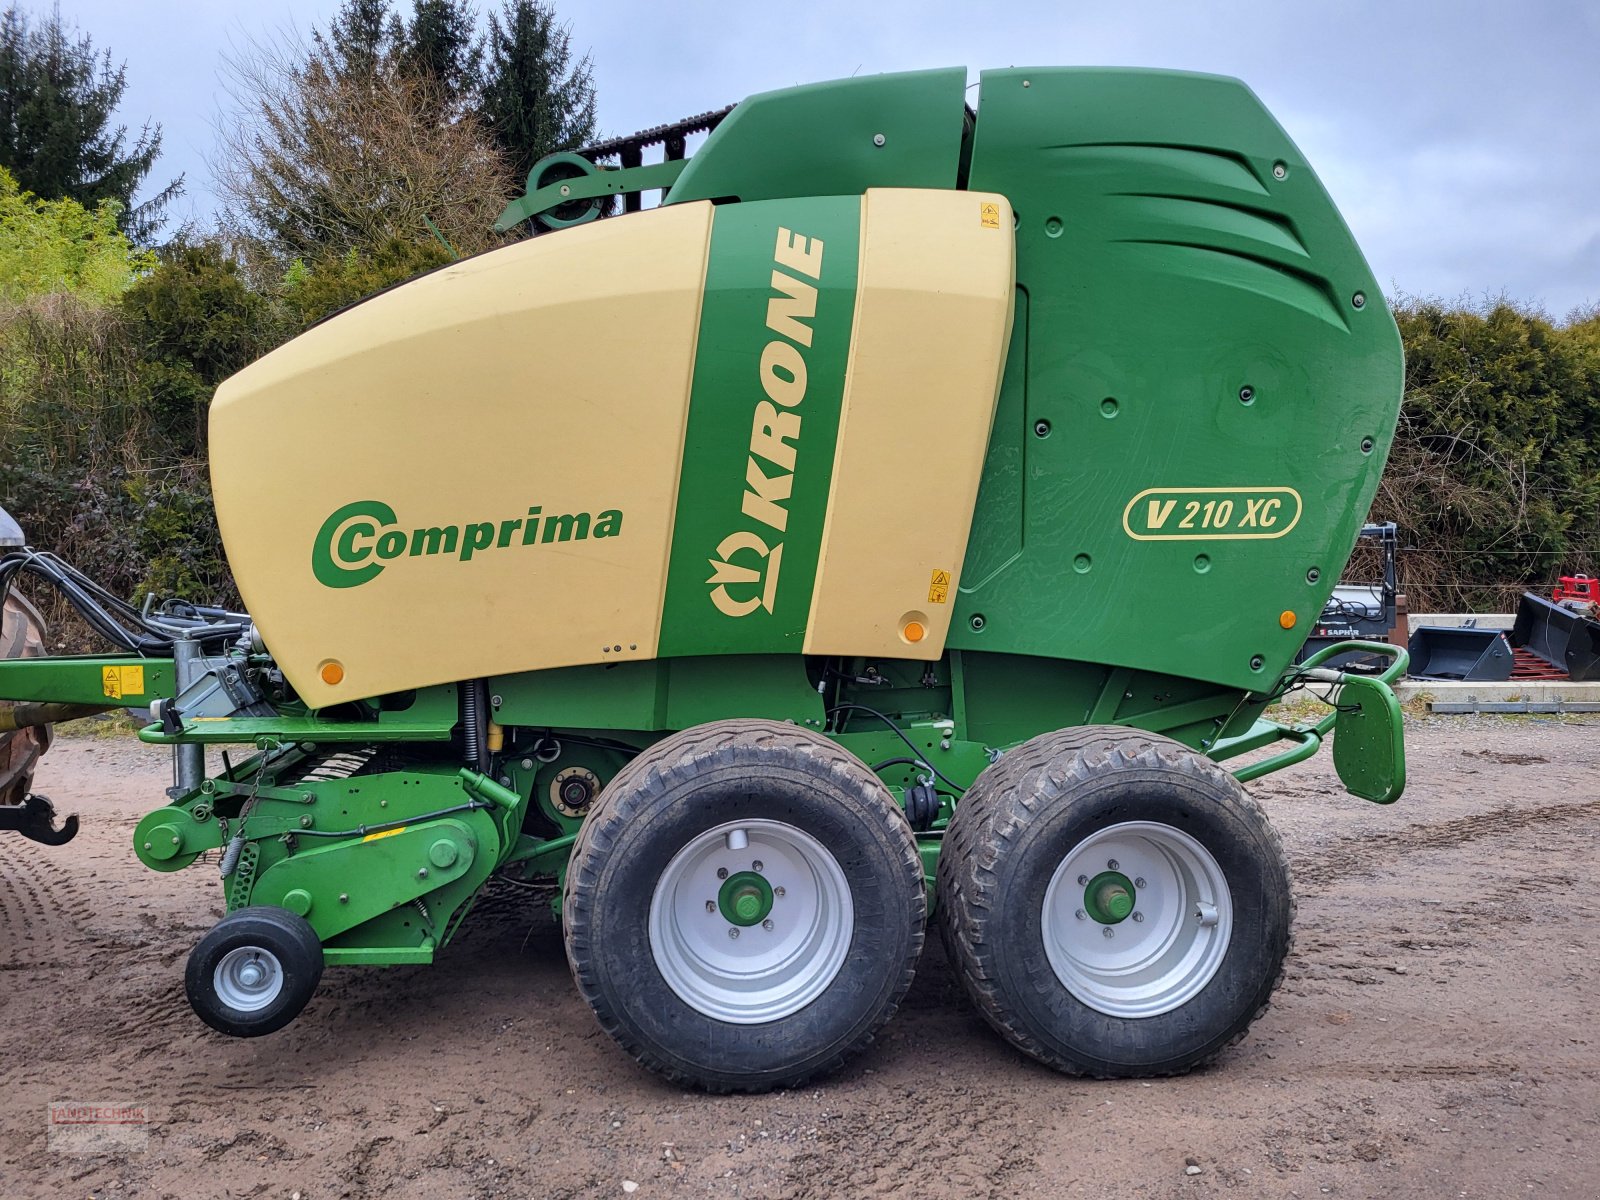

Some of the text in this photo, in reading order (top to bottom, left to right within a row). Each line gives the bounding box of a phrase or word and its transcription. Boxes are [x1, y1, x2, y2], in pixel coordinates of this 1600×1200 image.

[742, 226, 824, 533] KRONE
[311, 500, 623, 589] Comprima
[1147, 498, 1281, 528] V 210 XC
